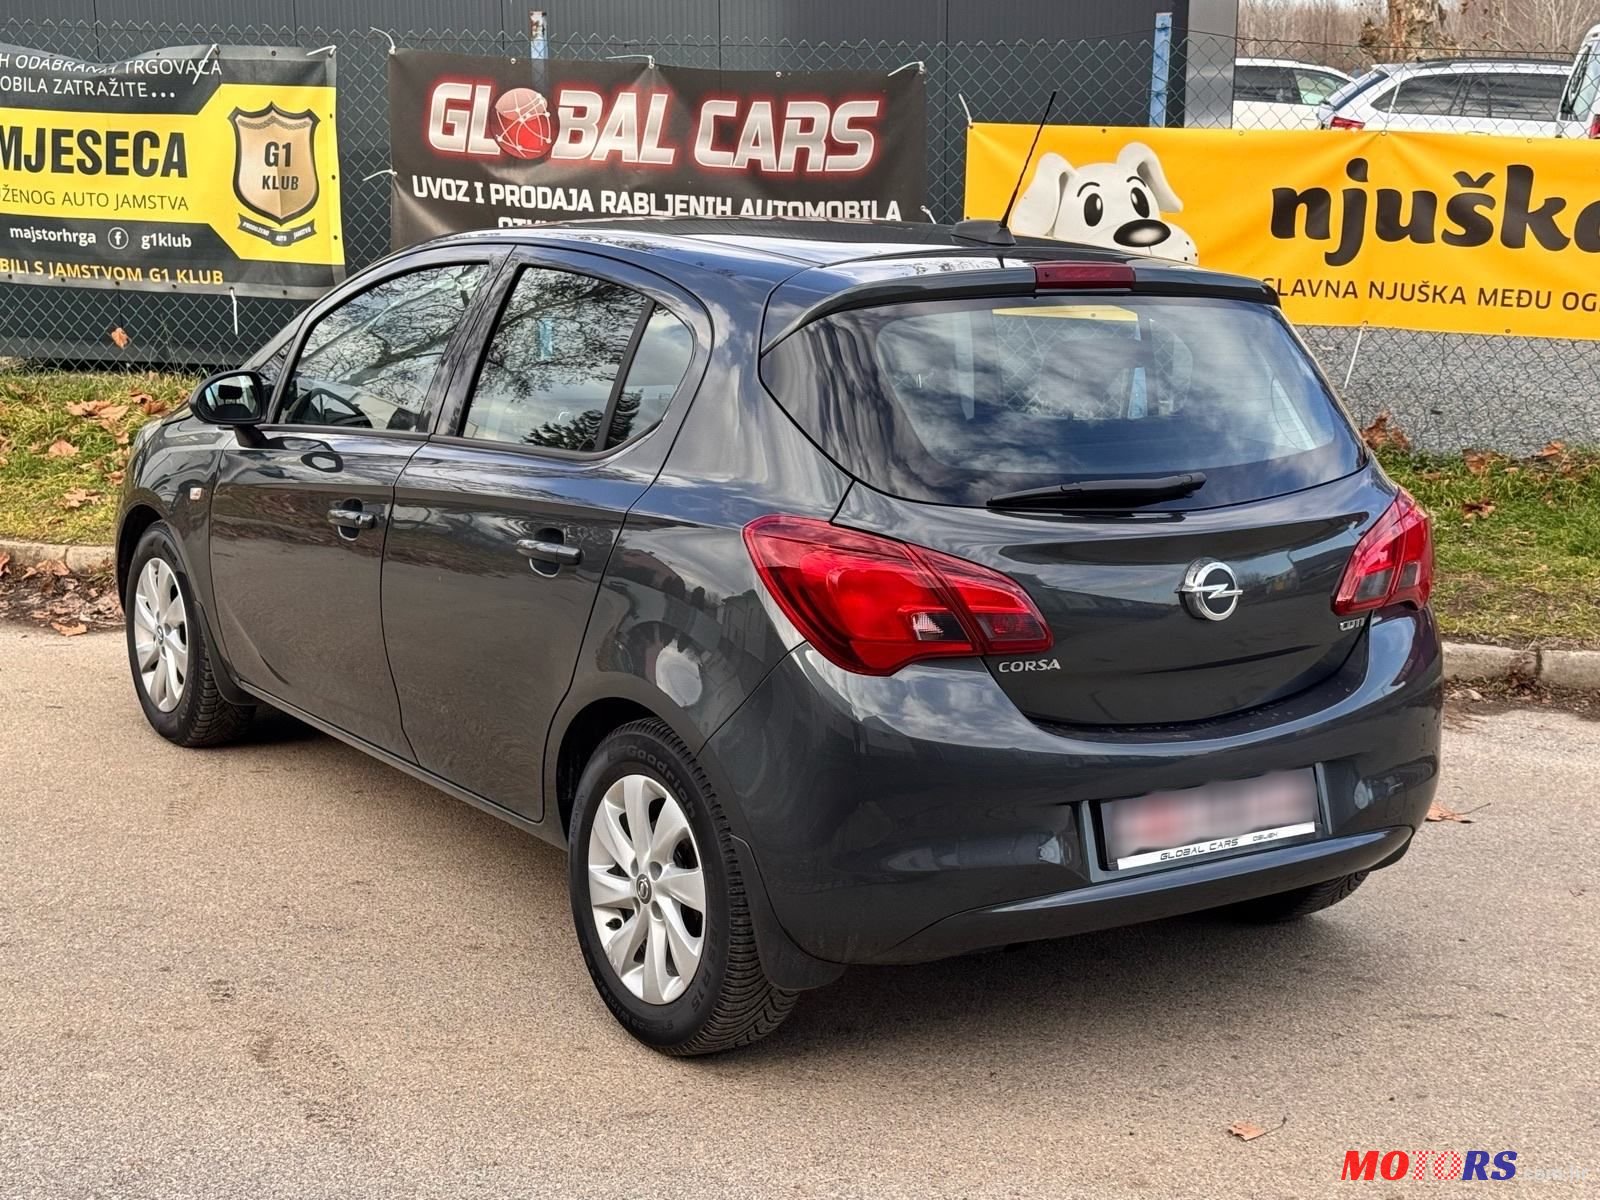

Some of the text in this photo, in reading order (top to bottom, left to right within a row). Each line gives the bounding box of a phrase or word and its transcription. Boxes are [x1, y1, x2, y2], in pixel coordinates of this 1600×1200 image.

[0, 75, 48, 94] OBILA
[694, 99, 880, 173] CARS
[0, 125, 188, 178] MJESECA
[264, 141, 292, 168] G1
[262, 175, 299, 190] KLUB
[2, 184, 190, 212] ŽENOG AUTO JAMSTVA
[412, 175, 903, 222] UVOZ I PRODAJA RABLJENIH AUTOMOBILA
[9, 226, 97, 246] majstorhrga
[141, 232, 192, 249] g1klub
[34, 260, 44, 276] S
[48, 261, 143, 282] JAMSTVOM
[149, 267, 170, 283] G1
[176, 268, 224, 285] KLUB
[1369, 280, 1467, 305] NJUŠKA
[1477, 287, 1552, 310] MEĐU
[998, 658, 1062, 673] CORSA
[1160, 846, 1206, 861] GLOBAL
[1209, 838, 1239, 851] CARS
